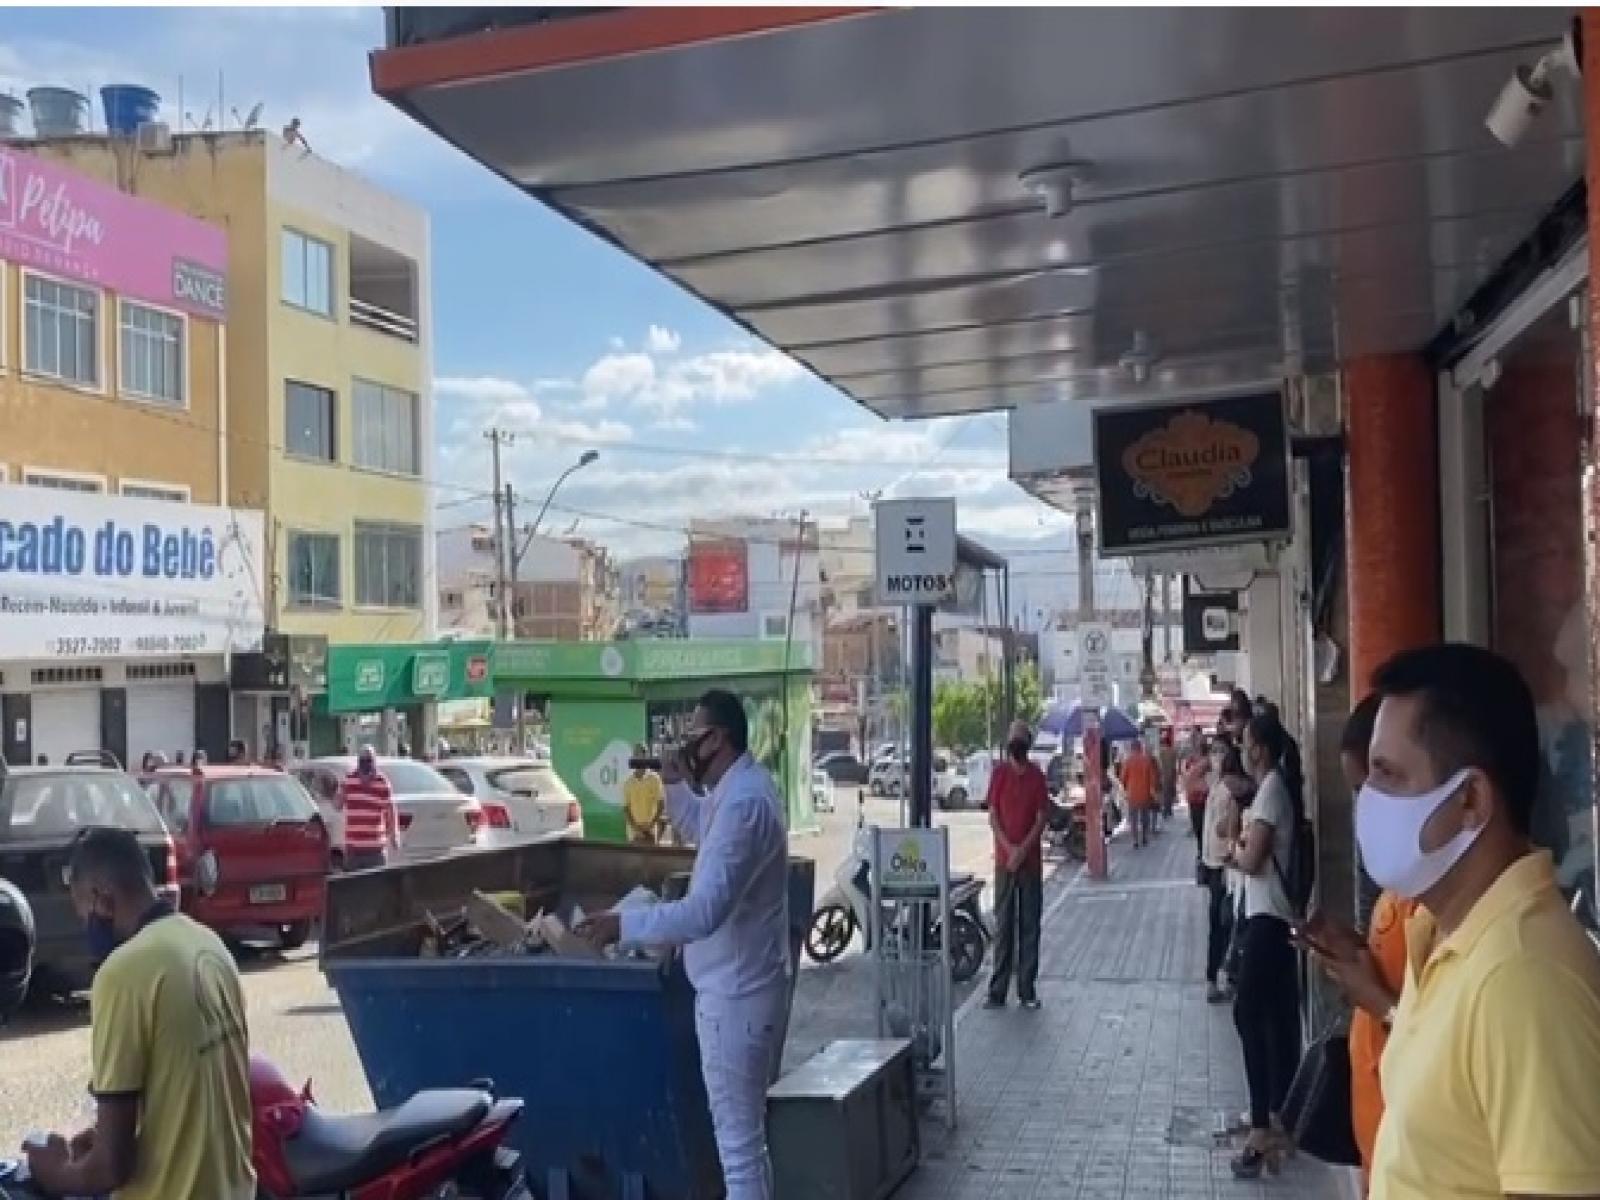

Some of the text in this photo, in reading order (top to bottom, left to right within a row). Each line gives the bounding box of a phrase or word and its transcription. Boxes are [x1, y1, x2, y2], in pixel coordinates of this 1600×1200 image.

[175, 271, 224, 309] DANCE
[1135, 440, 1241, 470] Claudia
[95, 519, 133, 577] do
[142, 524, 214, 579] Bebê
[887, 574, 946, 593] MOTOS
